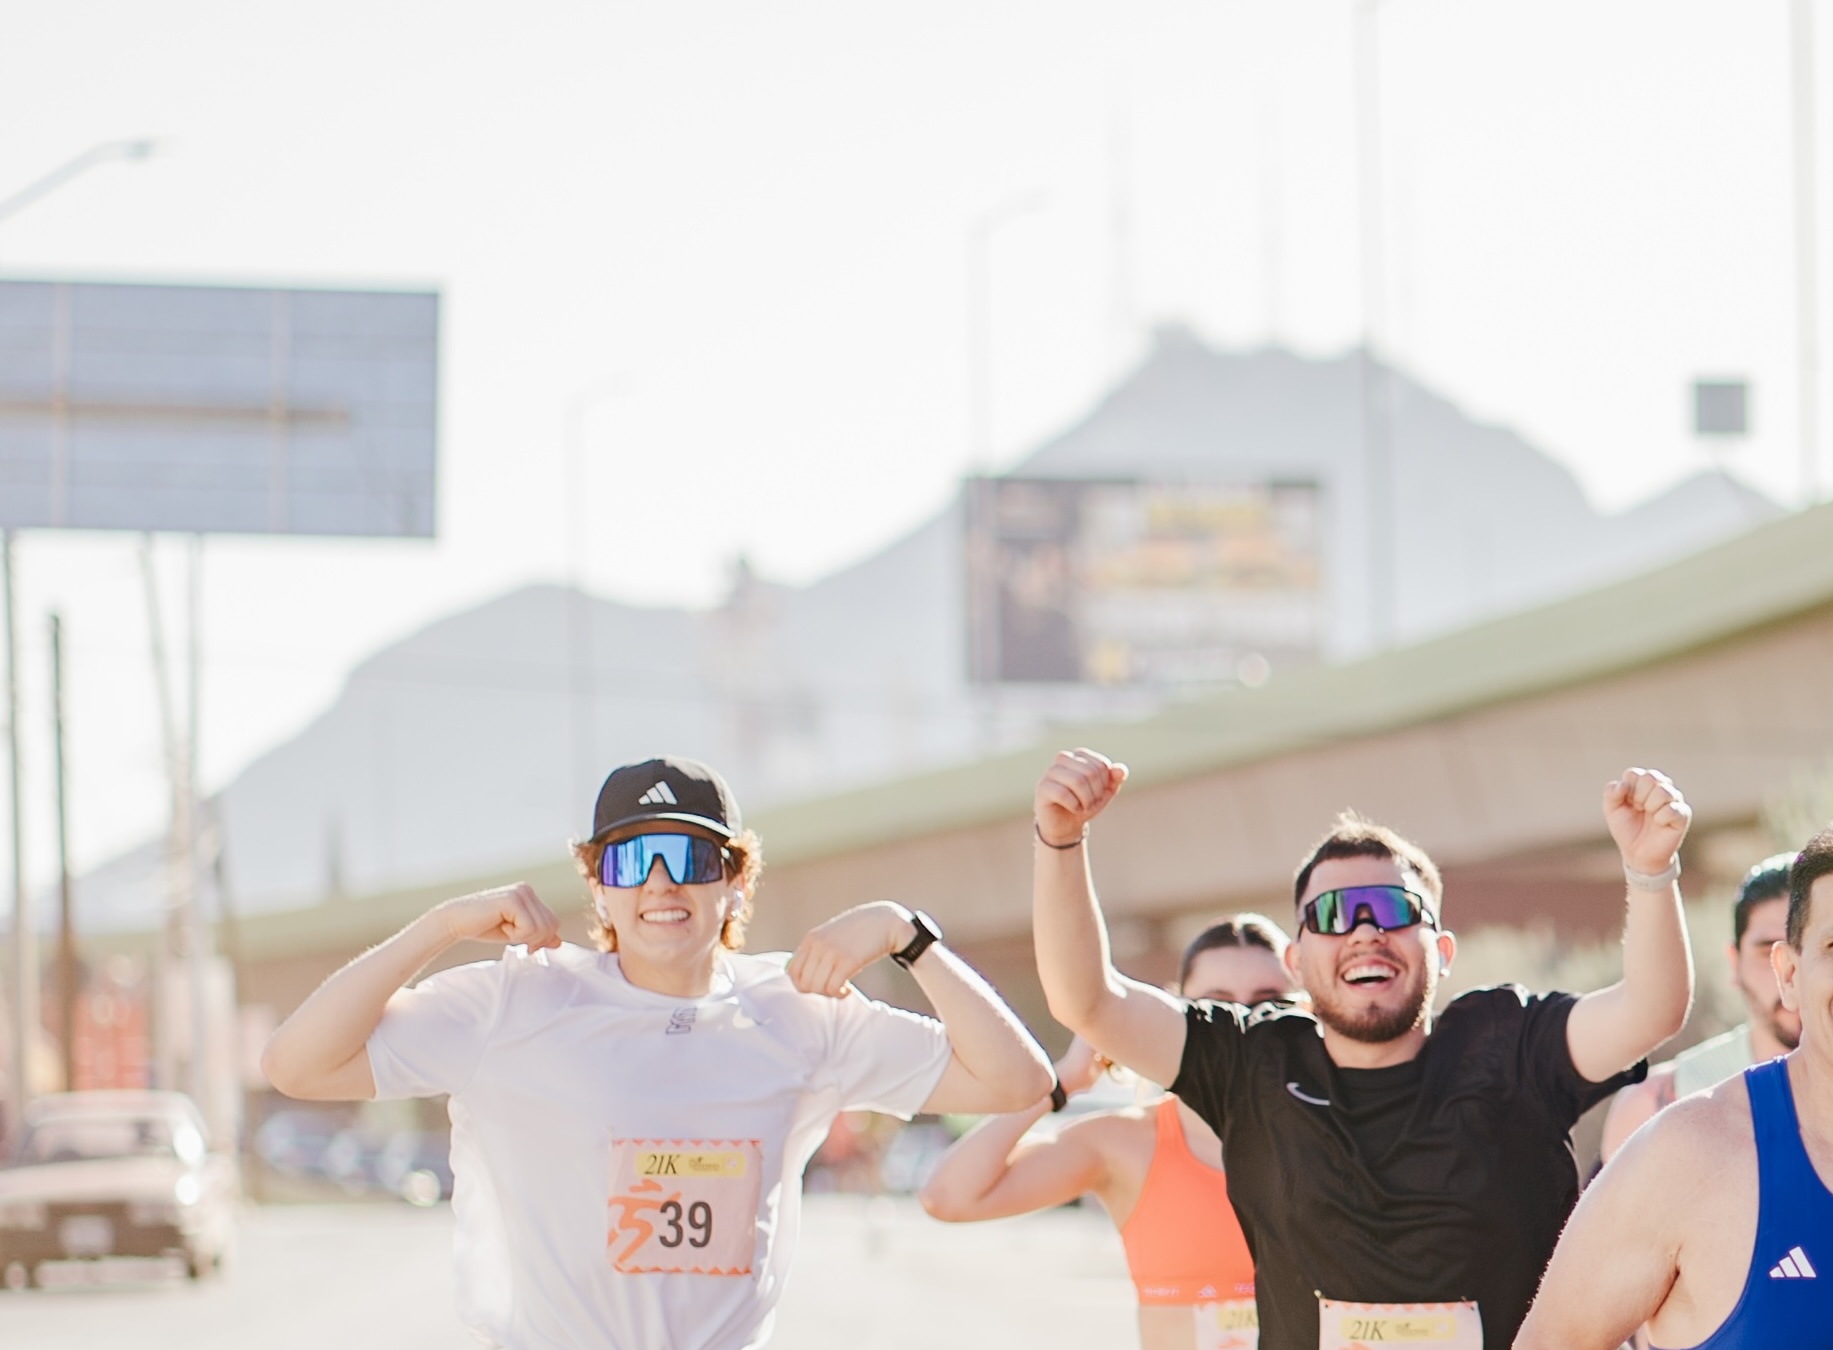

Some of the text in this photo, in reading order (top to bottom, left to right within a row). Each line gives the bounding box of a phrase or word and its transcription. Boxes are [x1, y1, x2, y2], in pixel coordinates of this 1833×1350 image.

[644, 1154, 680, 1174] 21K
[658, 1200, 713, 1248] 39
[1349, 1320, 1386, 1340] 21K
